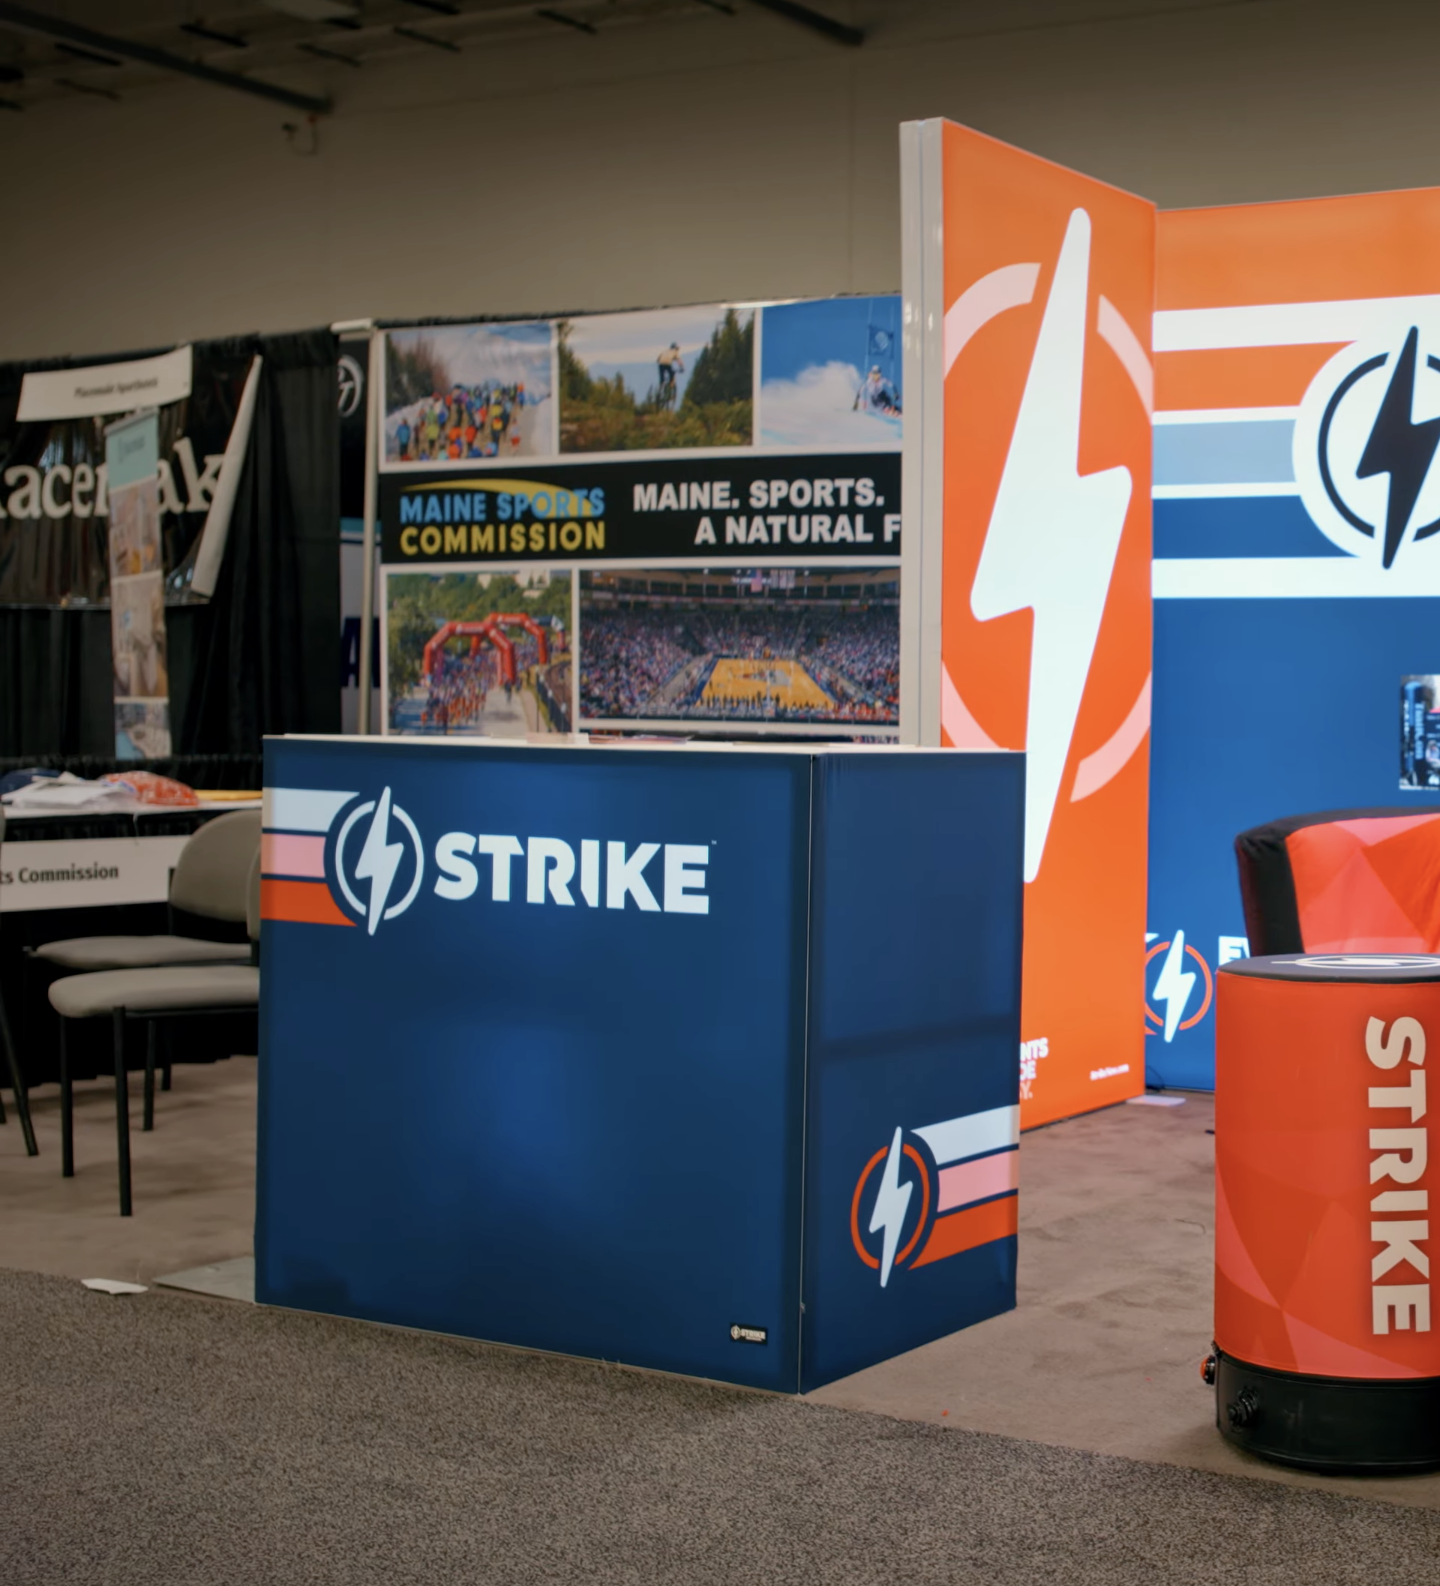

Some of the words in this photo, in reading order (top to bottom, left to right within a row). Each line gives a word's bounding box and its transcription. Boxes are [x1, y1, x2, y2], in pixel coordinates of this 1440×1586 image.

[401, 492, 486, 524] MAINE
[497, 488, 605, 520] SPORTS
[633, 481, 740, 512] MAINE.
[749, 478, 885, 509] SPORTS.
[401, 521, 605, 555] COMMISSION
[694, 516, 718, 545] A
[725, 513, 875, 545] NATURAL
[18, 862, 119, 884] Commission
[433, 831, 710, 915] STRIKE
[1365, 1016, 1431, 1335] STRIKE
